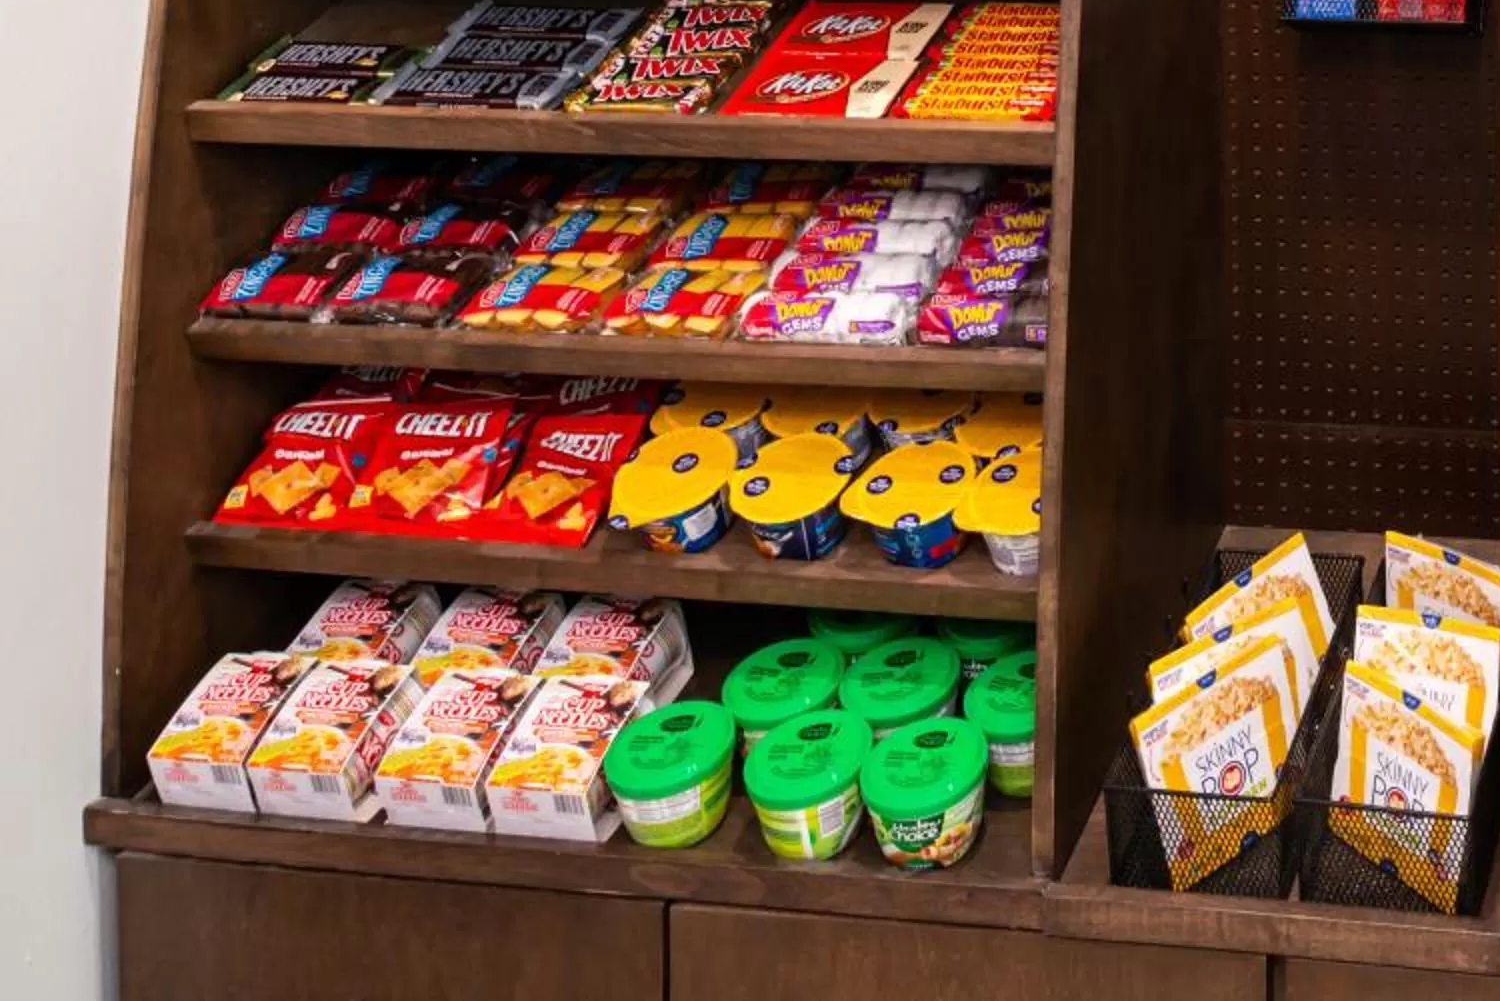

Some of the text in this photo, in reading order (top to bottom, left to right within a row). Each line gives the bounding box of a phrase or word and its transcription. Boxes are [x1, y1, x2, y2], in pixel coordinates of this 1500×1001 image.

[666, 26, 752, 56] TWIX
[632, 56, 721, 81] TWIX
[401, 70, 527, 95] HERSHEY'S
[968, 263, 1024, 285] DONUT
[776, 298, 831, 322] DONUT
[949, 302, 1003, 329] DONUT
[781, 316, 822, 335] GEMS
[957, 323, 999, 341] GEMS
[230, 672, 272, 687] CUP
[327, 680, 369, 695] CUP
[454, 690, 498, 705] CUP
[563, 697, 605, 712] CUP
[1376, 751, 1428, 795] SKINNY
